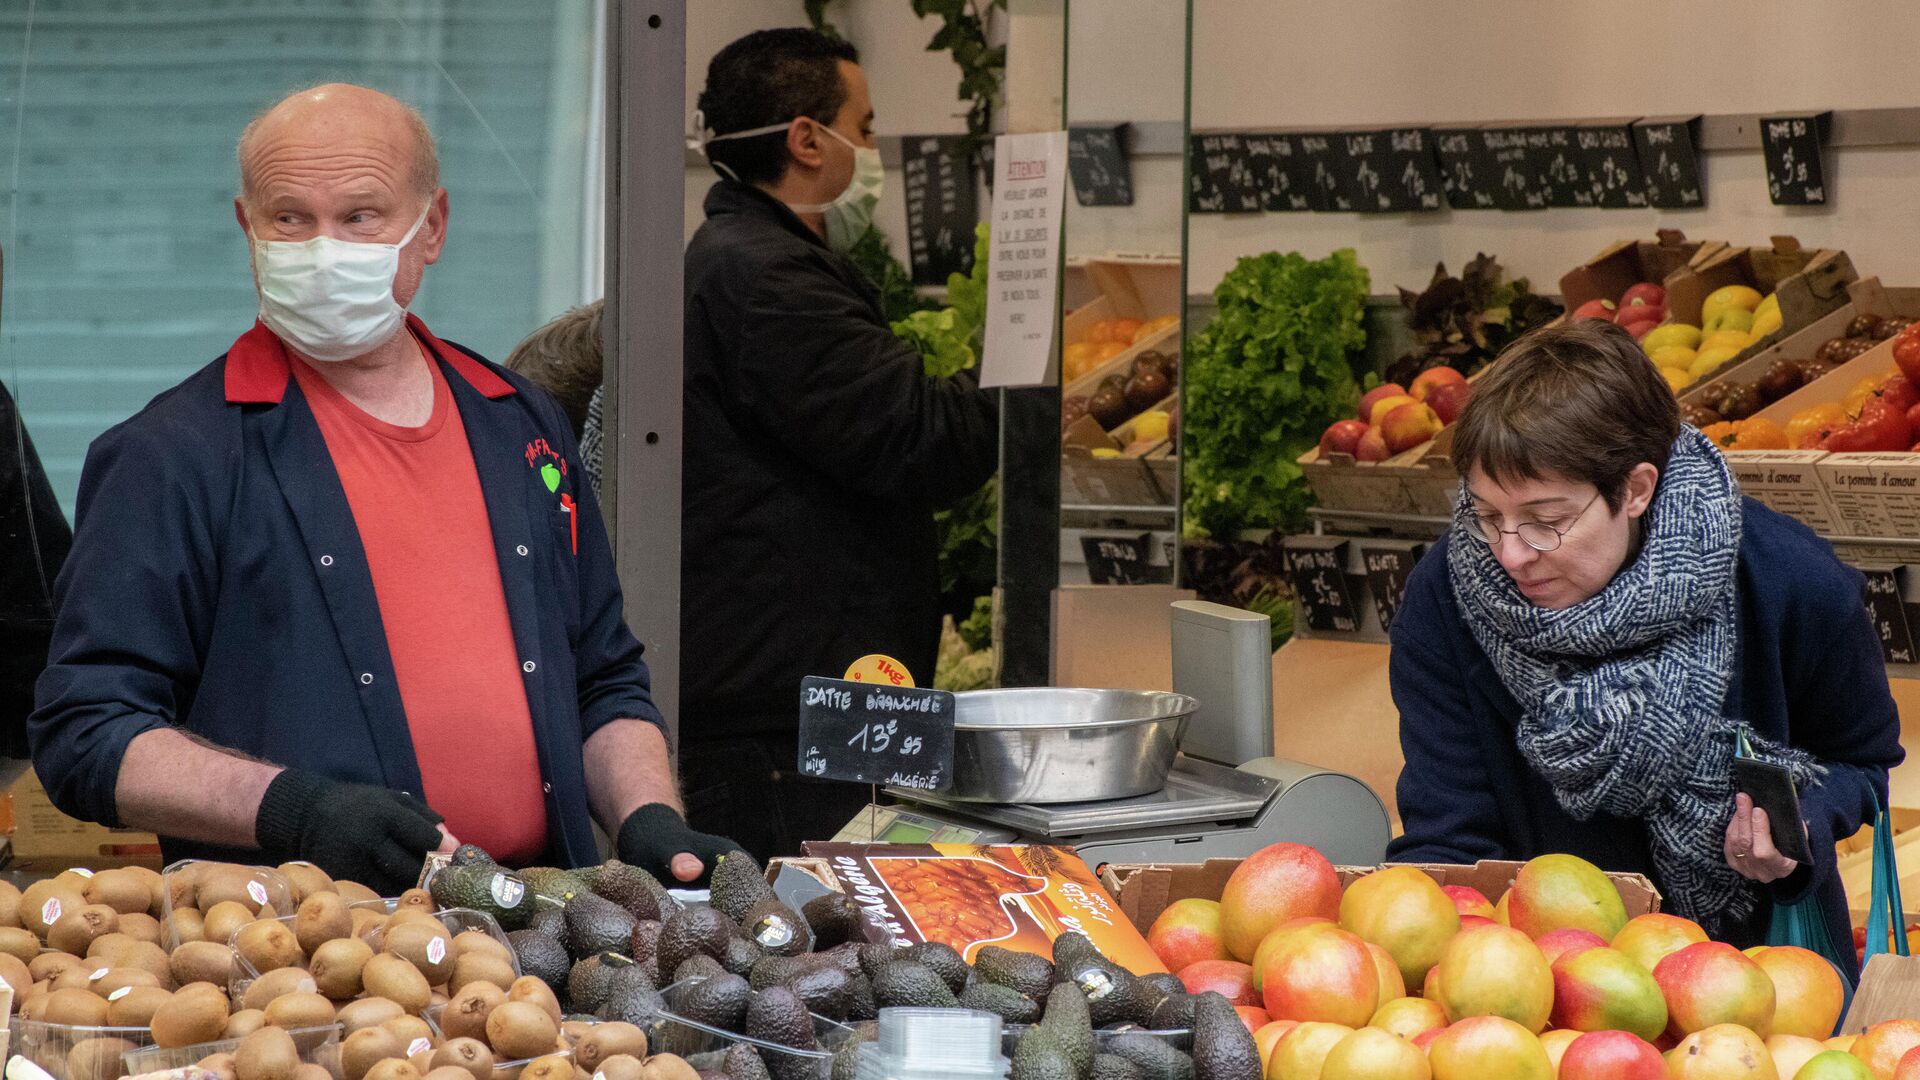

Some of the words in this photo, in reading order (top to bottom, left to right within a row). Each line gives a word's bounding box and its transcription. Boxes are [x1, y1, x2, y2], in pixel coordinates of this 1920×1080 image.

[1008, 160, 1047, 177] ATTENTION
[1847, 474, 1877, 490] pomme
[1881, 472, 1917, 487] d'amour
[877, 660, 905, 686] 1kg
[806, 687, 852, 710] DATTE
[899, 736, 922, 755] 95
